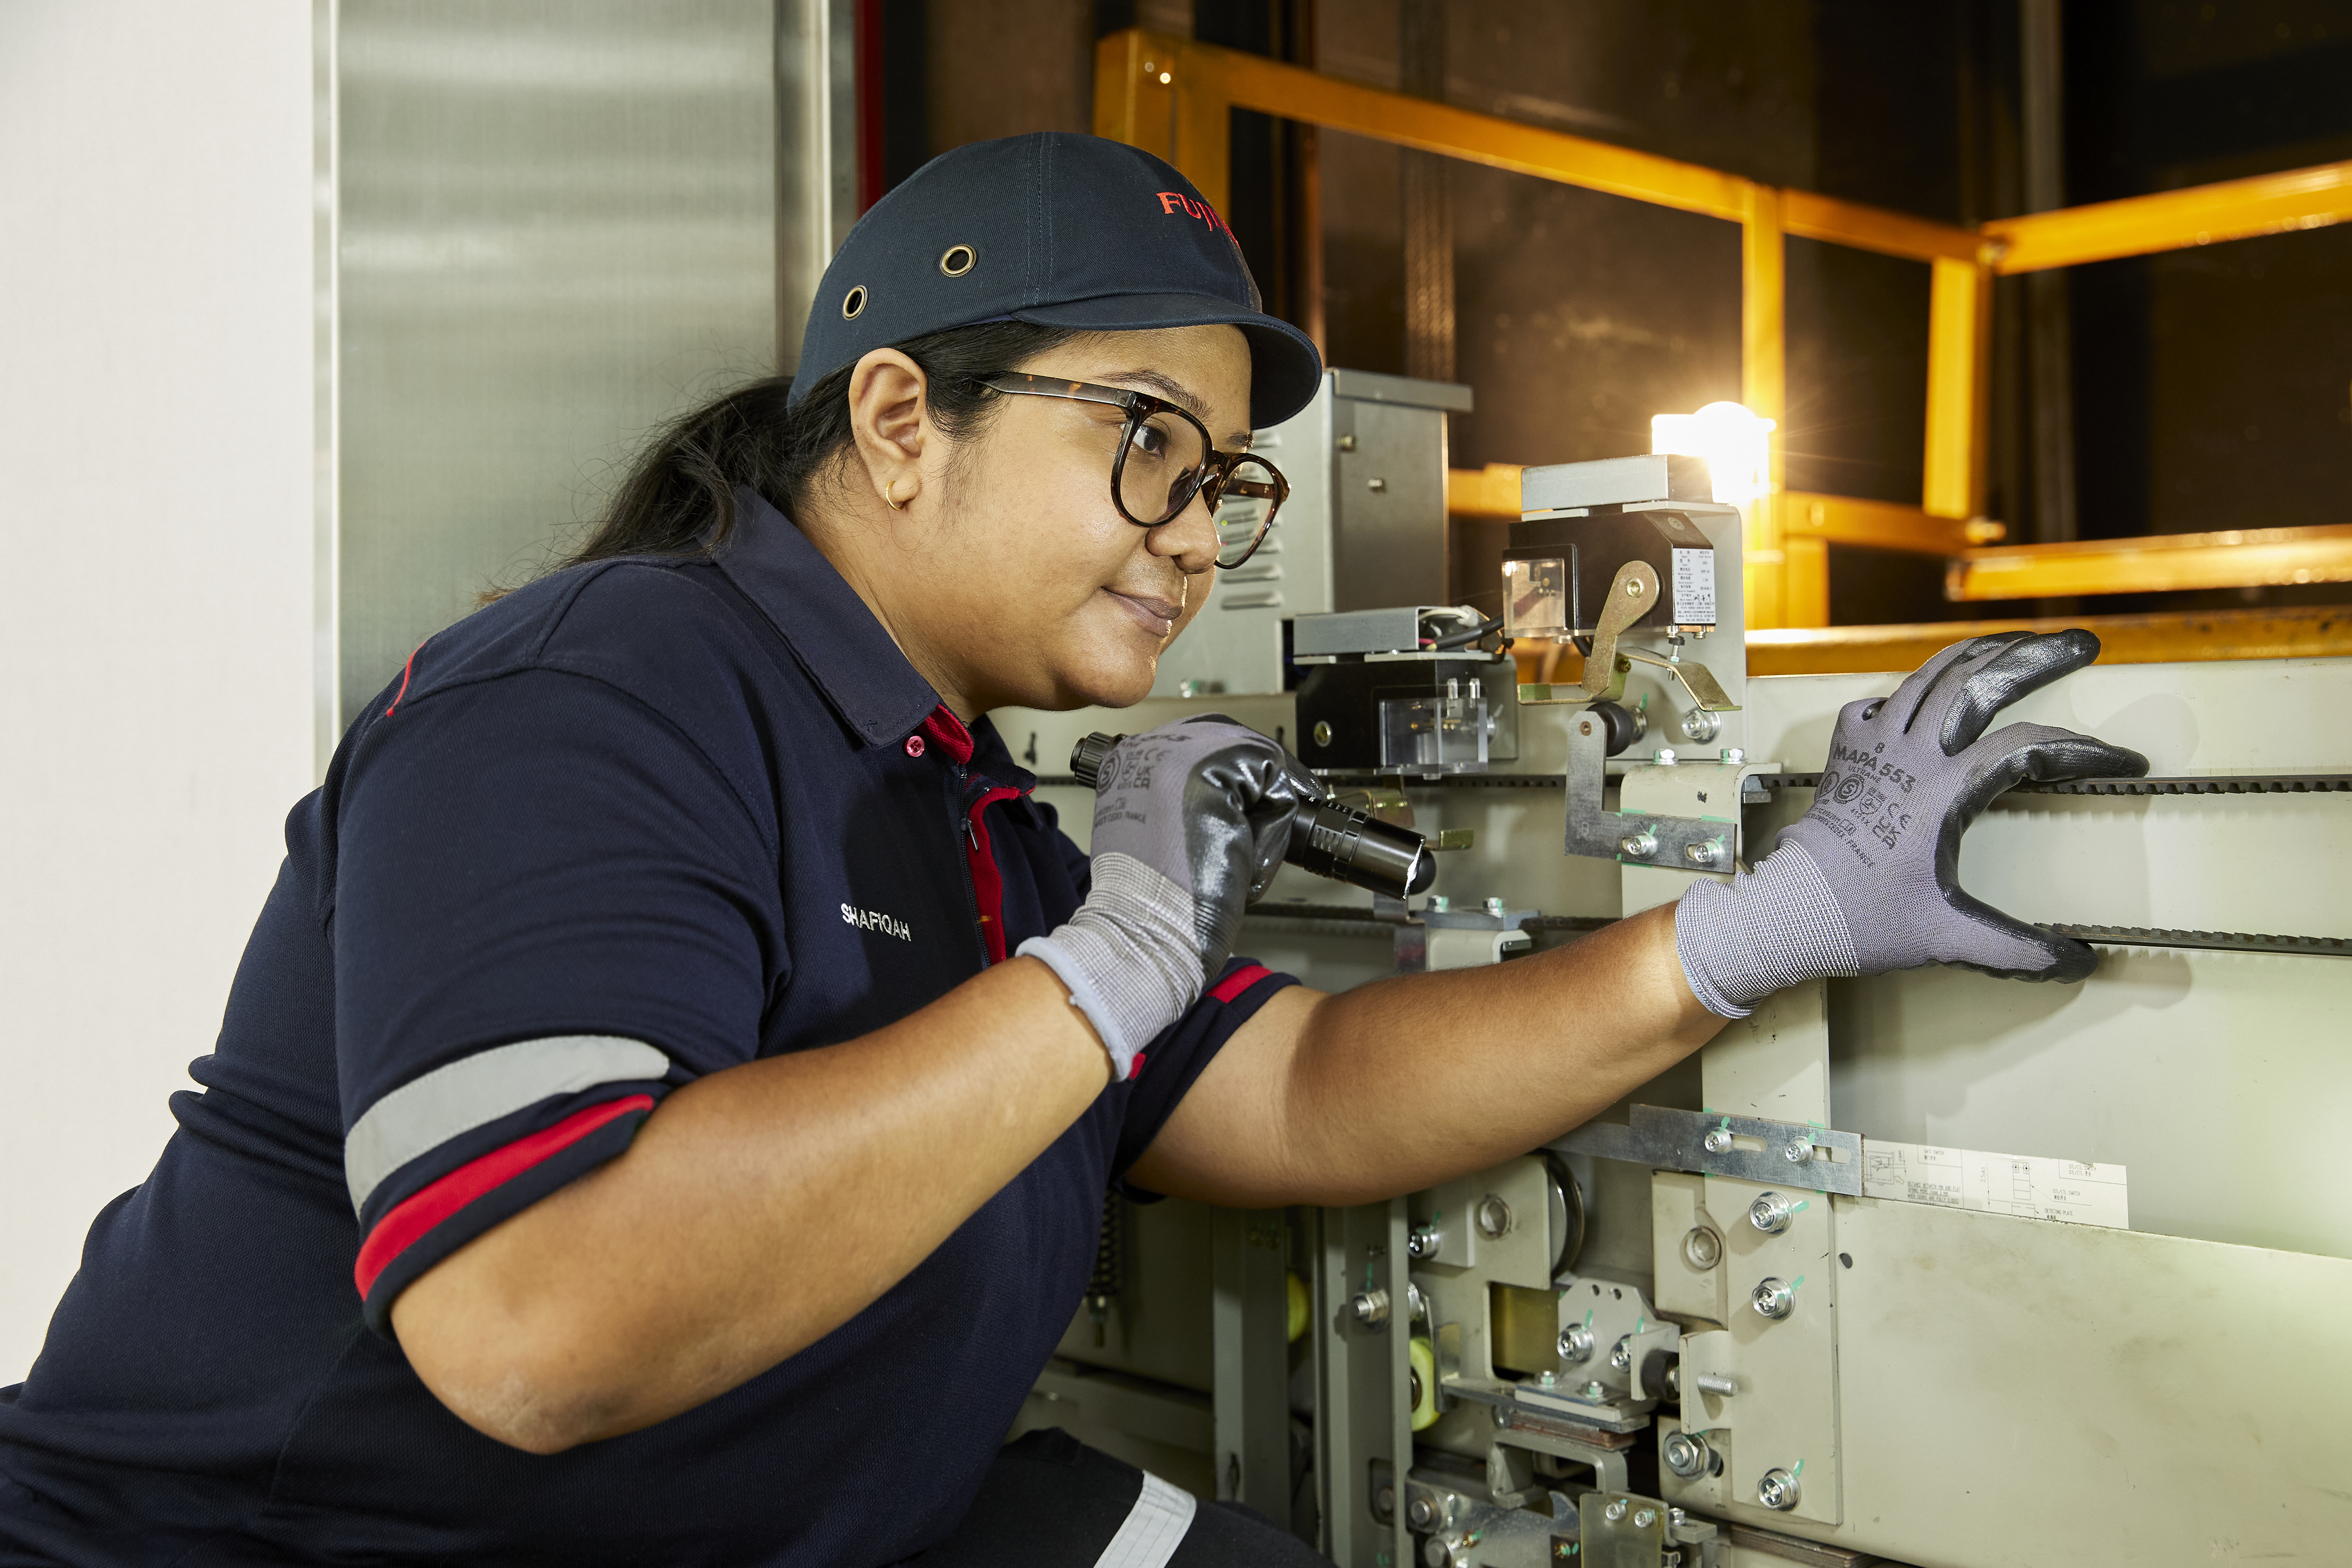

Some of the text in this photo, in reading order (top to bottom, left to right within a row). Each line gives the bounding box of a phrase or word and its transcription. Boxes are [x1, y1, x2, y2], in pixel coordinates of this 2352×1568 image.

[1874, 742, 1885, 753] 8
[1833, 742, 1916, 793] MAPA 553
[1849, 766, 1881, 783] ULTRANE
[841, 903, 911, 941] SHAFIQAH
